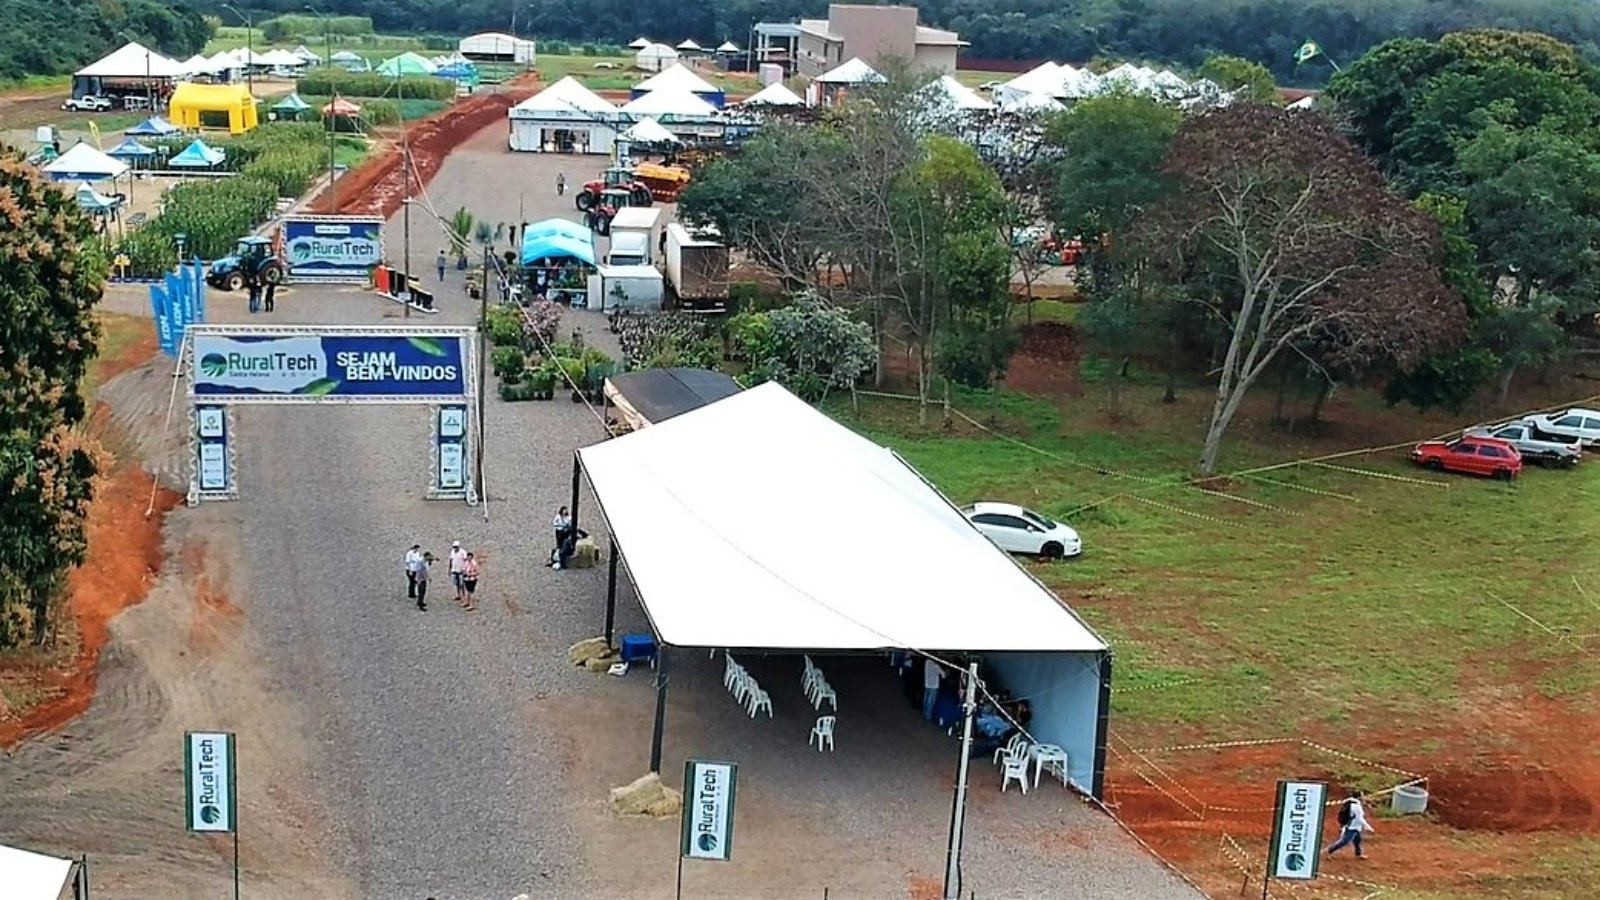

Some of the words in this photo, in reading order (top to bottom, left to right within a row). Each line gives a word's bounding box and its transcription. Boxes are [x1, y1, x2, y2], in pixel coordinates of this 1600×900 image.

[312, 241, 374, 255] RuralTech
[229, 352, 317, 370] RuralTech
[336, 351, 396, 367] SEJAM
[346, 365, 457, 380] BEM-VINDOS
[199, 739, 214, 804] RuralTech
[698, 769, 717, 833] RuralTech
[1286, 788, 1308, 852] RuralTech
